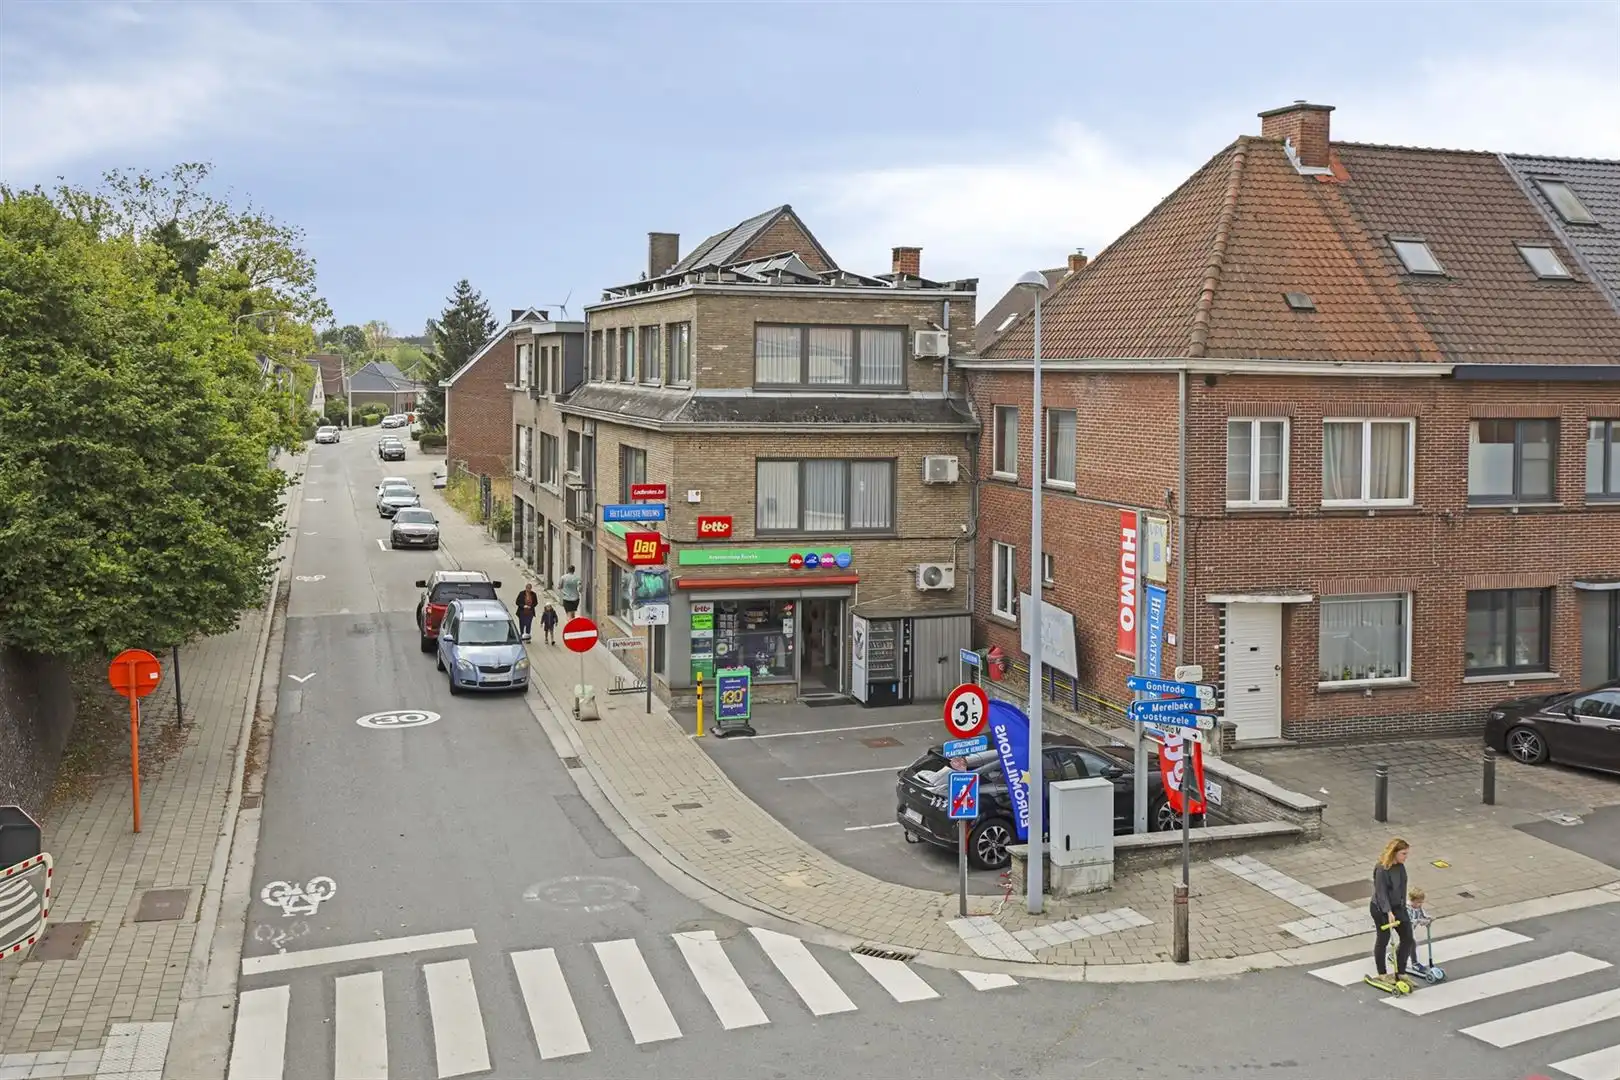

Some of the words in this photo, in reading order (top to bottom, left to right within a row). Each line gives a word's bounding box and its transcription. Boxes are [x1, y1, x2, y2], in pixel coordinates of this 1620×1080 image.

[633, 539, 657, 559] Dag
[1120, 528, 1136, 632] HUMO
[1146, 681, 1186, 695] Gontrode
[1151, 702, 1194, 712] Merelbeke
[1142, 713, 1189, 725] Oosterzele
